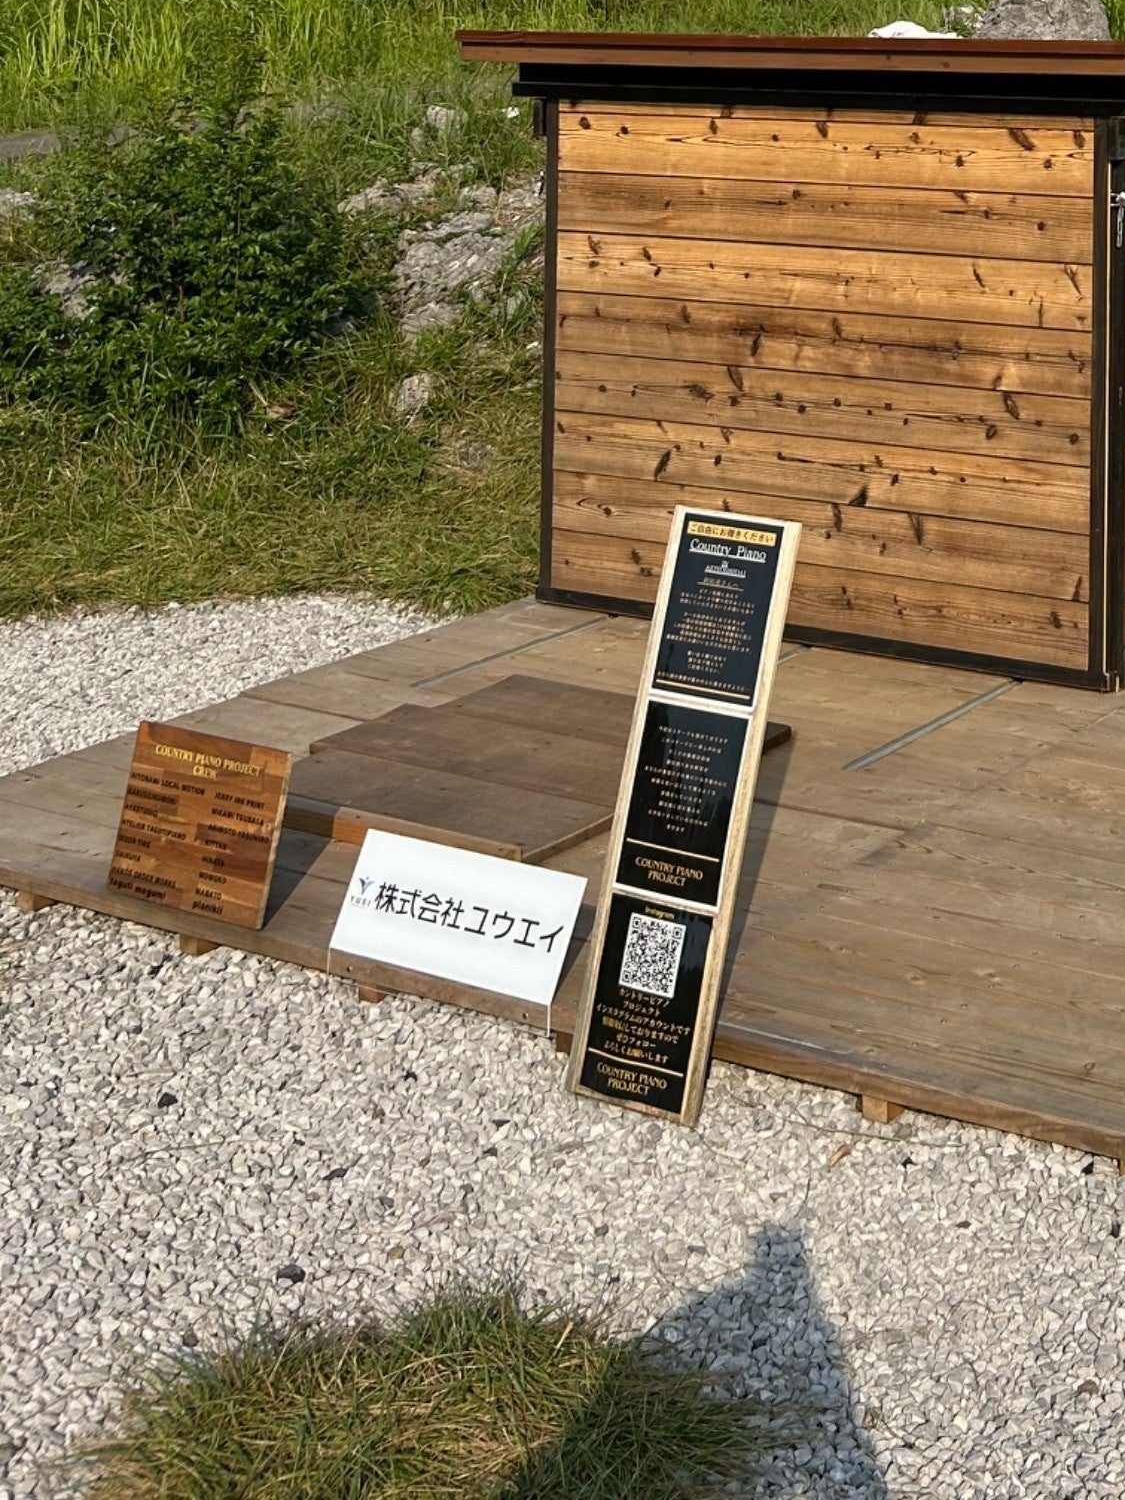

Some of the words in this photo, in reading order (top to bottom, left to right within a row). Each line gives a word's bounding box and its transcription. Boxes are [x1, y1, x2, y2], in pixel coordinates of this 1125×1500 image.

[690, 538, 731, 555] Country
[736, 545, 766, 560] Piano
[155, 743, 194, 761] COUNTRY
[194, 752, 222, 768] PIANO
[223, 758, 261, 777] PROJECT
[634, 856, 675, 873] COUNTRY
[675, 865, 703, 880] PIANO
[647, 869, 686, 886] PROJECT
[374, 881, 565, 954] 株式会社ユウエイ
[597, 1061, 637, 1081] COUNTRY
[638, 1073, 667, 1089] PIANO
[607, 1076, 650, 1095] PROJECT
